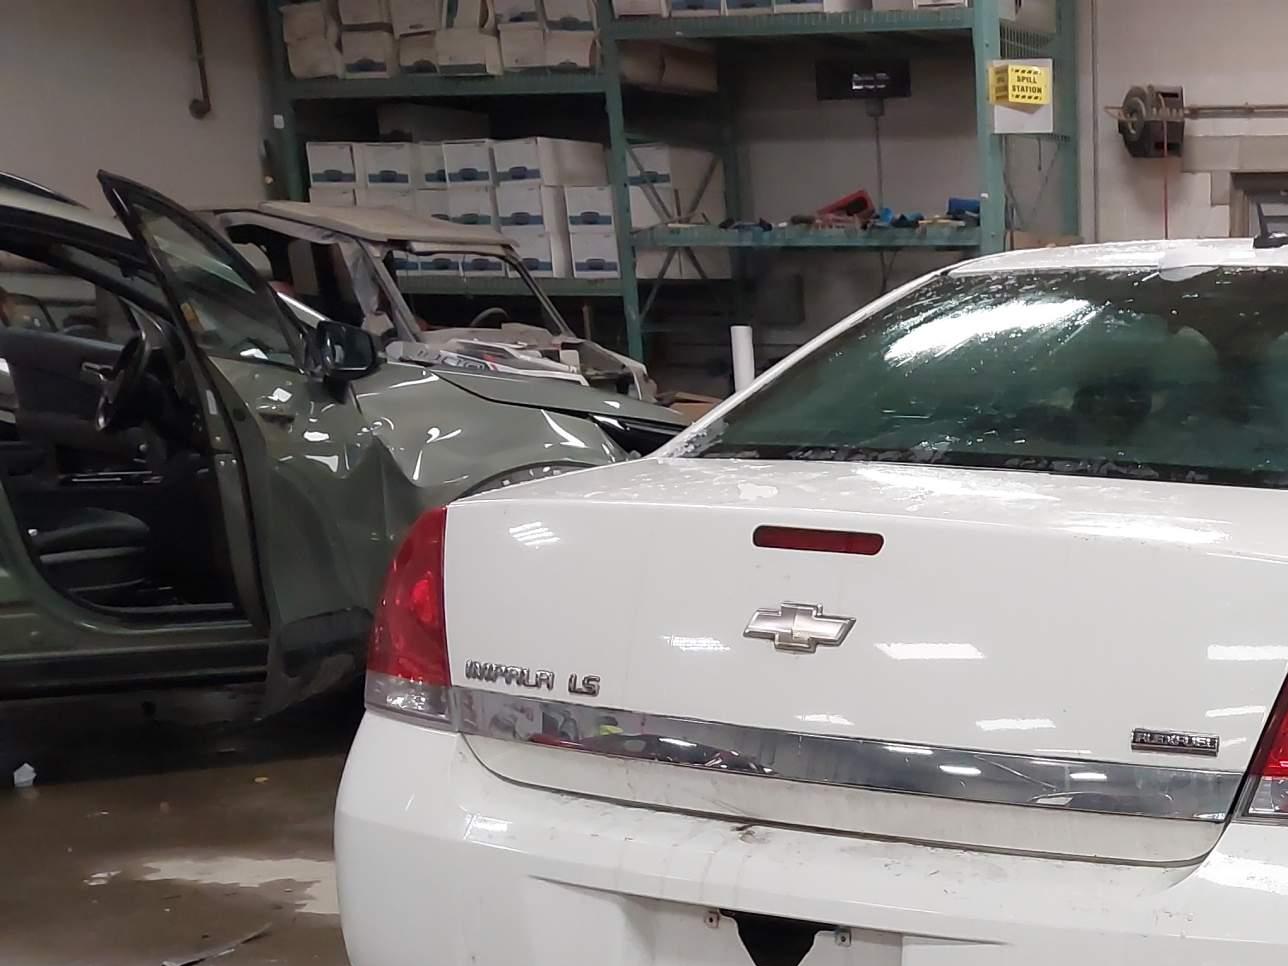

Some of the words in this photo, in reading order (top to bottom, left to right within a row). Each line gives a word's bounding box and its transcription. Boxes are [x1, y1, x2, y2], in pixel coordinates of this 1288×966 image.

[1016, 75, 1038, 84] SPILL
[1011, 85, 1042, 94] STATION
[465, 659, 555, 691] IMPALA
[568, 673, 601, 697] LS
